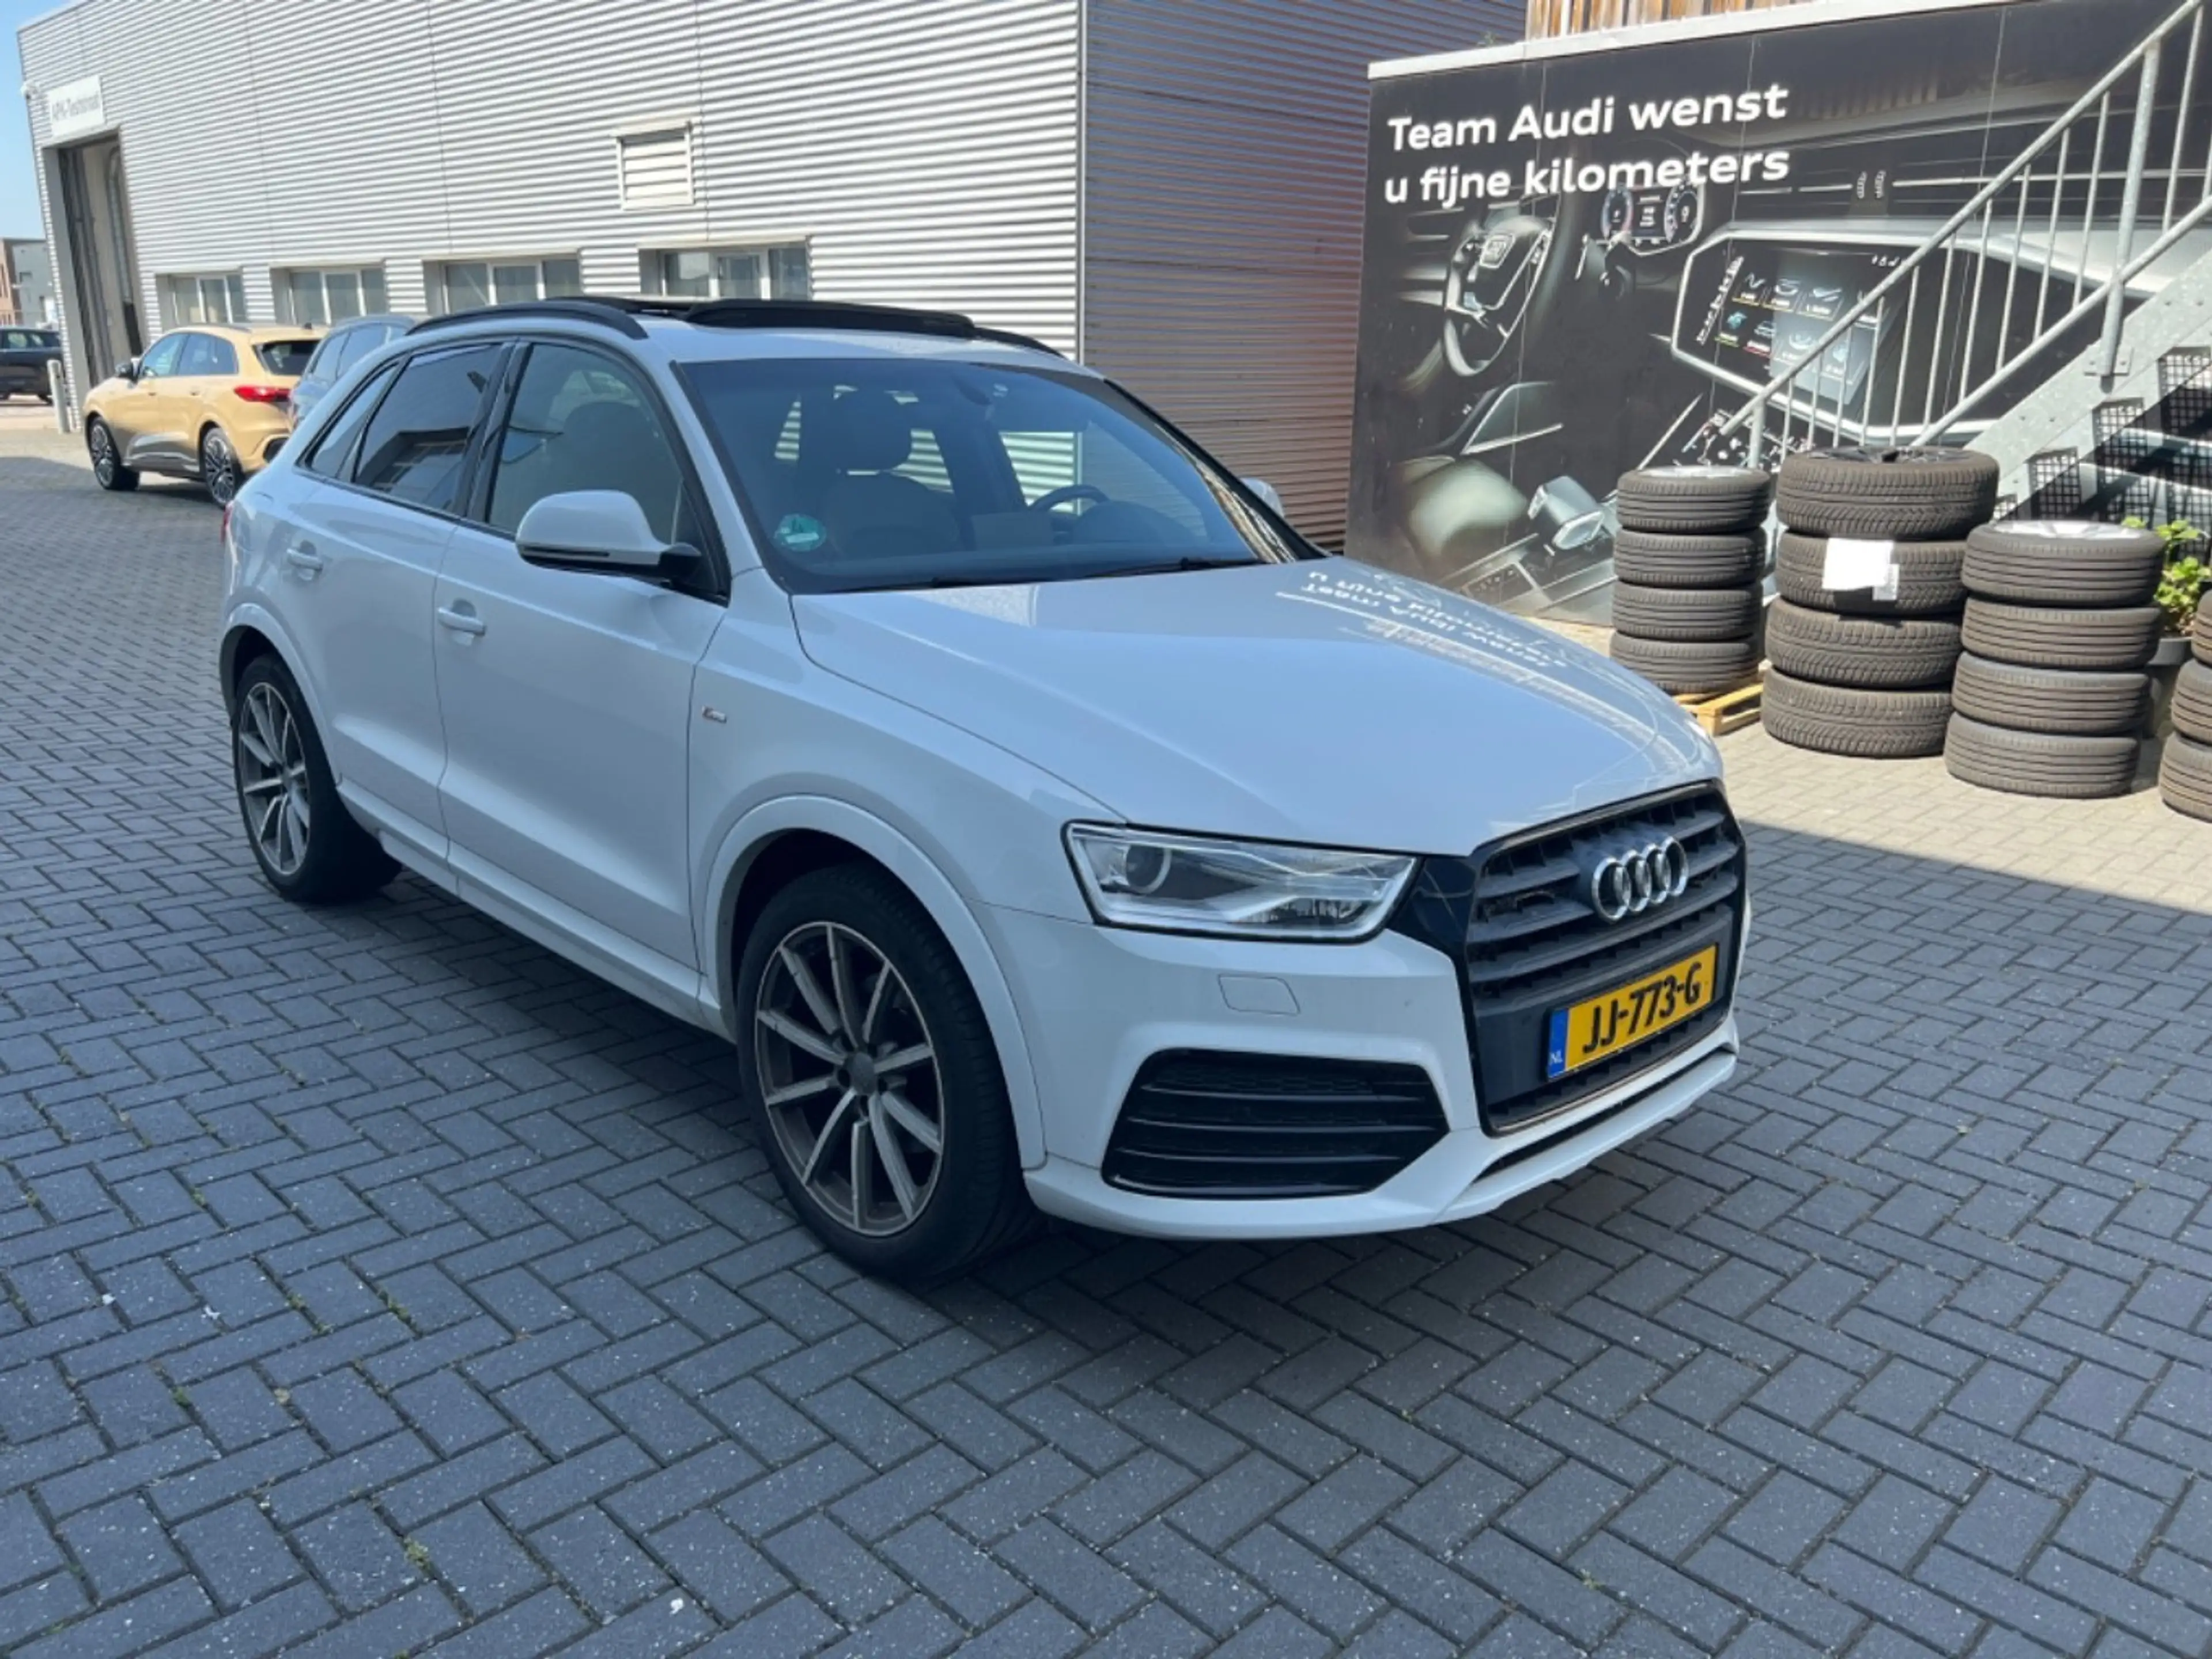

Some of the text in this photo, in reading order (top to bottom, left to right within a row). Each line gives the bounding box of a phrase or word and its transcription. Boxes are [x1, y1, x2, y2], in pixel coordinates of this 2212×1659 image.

[1387, 84, 1789, 150] Team Audi wenst
[1385, 151, 1790, 210] u fijne kilometers
[1581, 961, 1703, 1055] JJ-773-G
